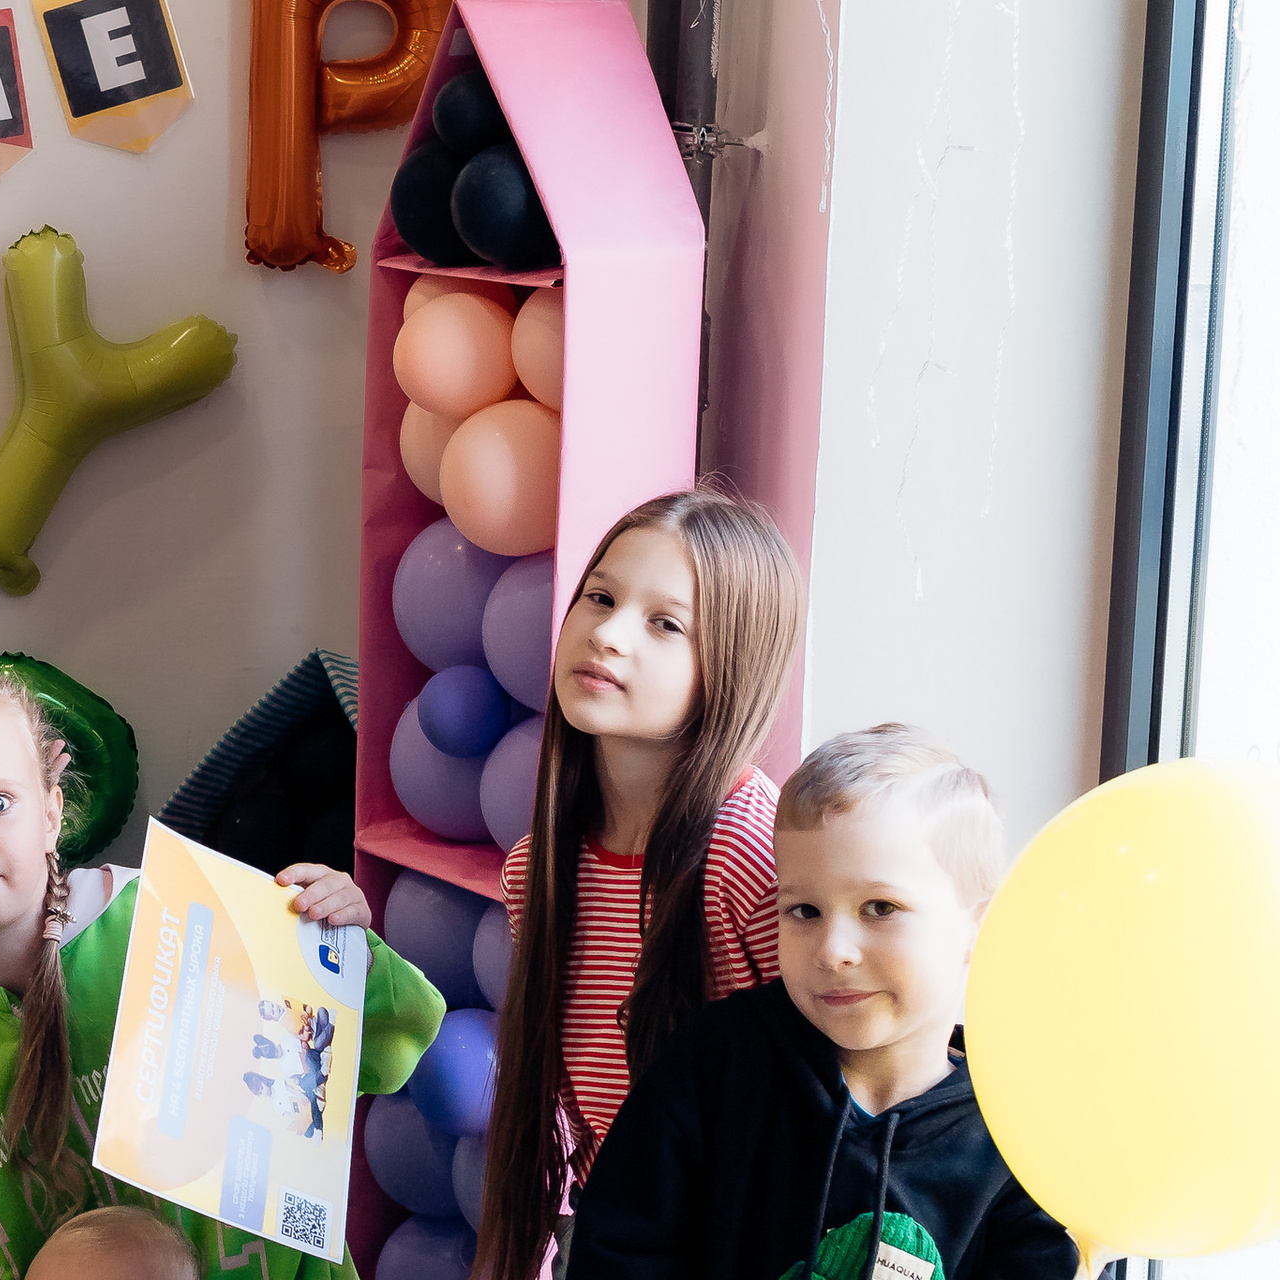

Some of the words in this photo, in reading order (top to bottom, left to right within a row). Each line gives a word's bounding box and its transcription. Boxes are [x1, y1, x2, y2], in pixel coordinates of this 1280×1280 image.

[188, 923, 206, 975] УРОКА
[210, 955, 222, 987] ЯЗЫКА
[135, 906, 181, 1105] СЕРТИФИКАТ
[174, 975, 198, 1079] БЕСПЛАТНЫХ
[167, 1092, 183, 1117] НА
[171, 1080, 182, 1091] 4
